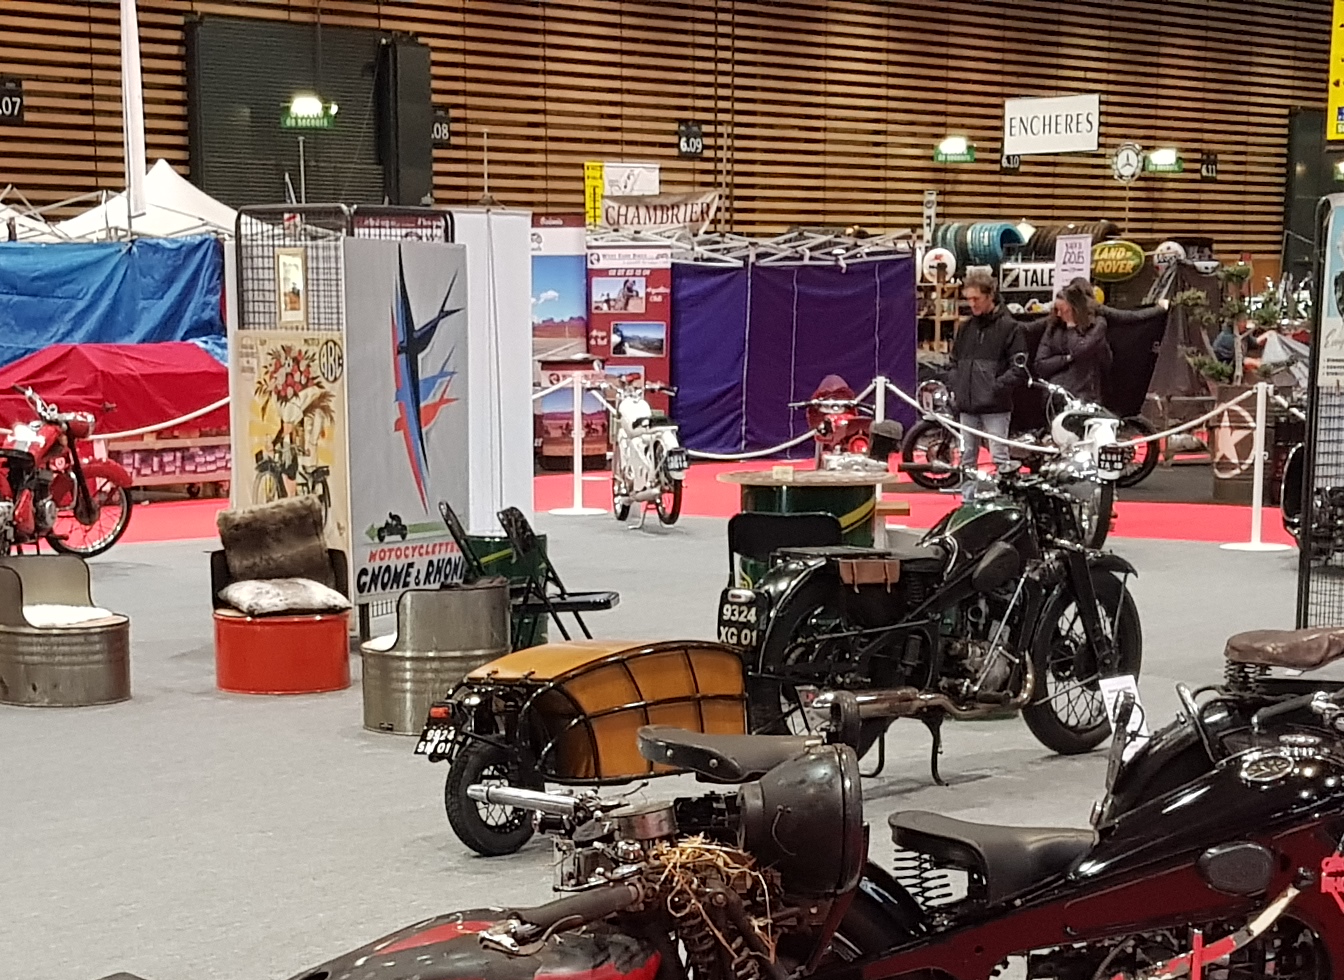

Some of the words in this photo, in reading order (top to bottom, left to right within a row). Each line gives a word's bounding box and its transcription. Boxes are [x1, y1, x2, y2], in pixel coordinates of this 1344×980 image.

[431, 123, 449, 140] .08
[1009, 111, 1094, 137] ENCHERES
[680, 137, 703, 153] 6.09
[1095, 259, 1136, 274] ROVER
[356, 561, 416, 594] GNOME
[722, 603, 757, 624] 9324
[719, 625, 738, 644] XG
[740, 628, 758, 647] 01
